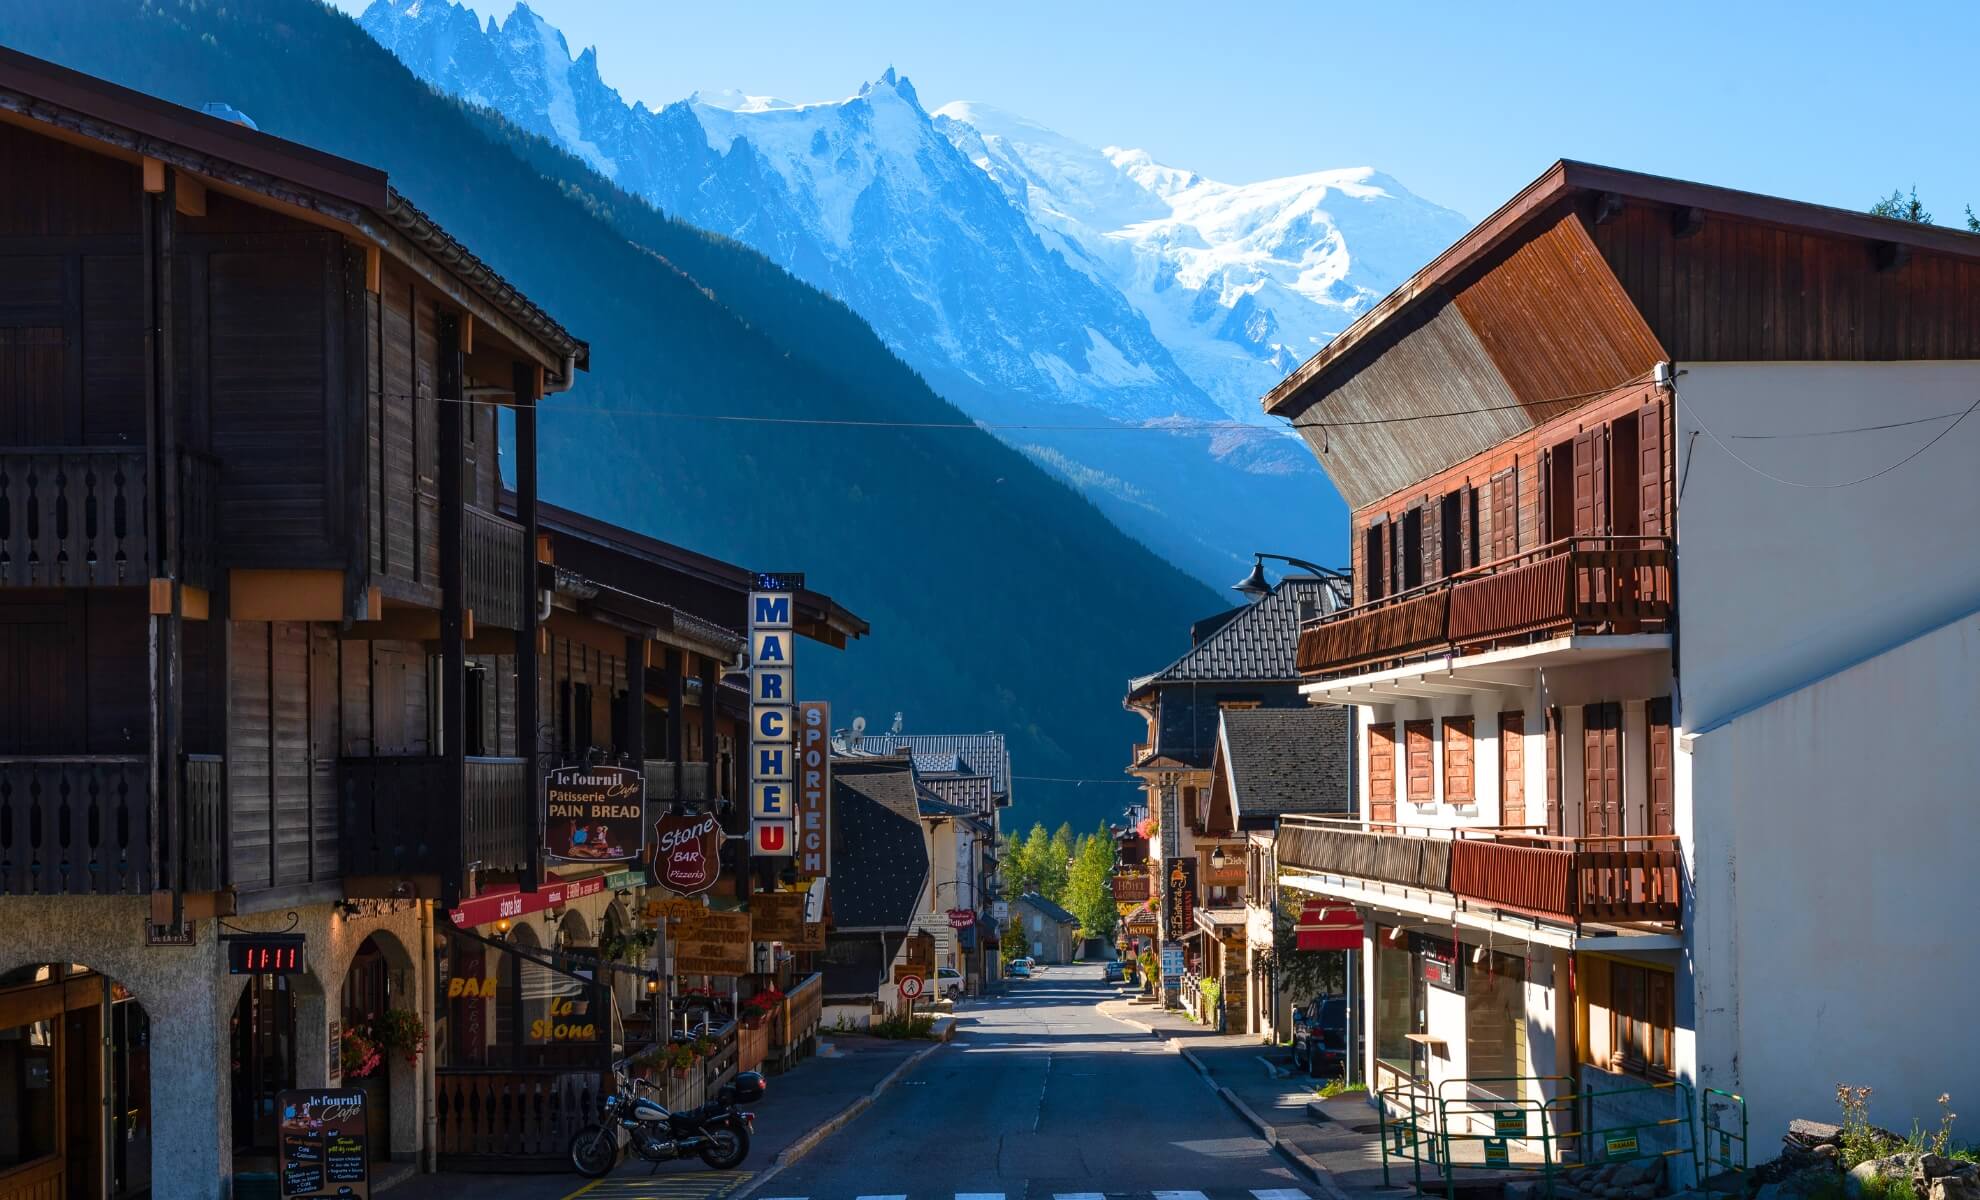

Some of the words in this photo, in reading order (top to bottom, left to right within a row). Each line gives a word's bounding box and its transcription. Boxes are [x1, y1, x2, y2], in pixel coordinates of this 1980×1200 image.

[556, 772, 570, 785] le
[572, 772, 622, 786] fournil
[549, 790, 605, 802] Pâtisserie
[805, 708, 822, 872] SPORTECH
[549, 804, 584, 817] PAIN
[591, 805, 640, 818] BREAD
[660, 818, 713, 851] Stone
[673, 851, 699, 862] BAR
[670, 870, 704, 880] Pizzeria
[1129, 926, 1154, 935] HOTEL
[247, 948, 295, 968] 11:11
[448, 977, 498, 999] BAR
[550, 996, 574, 1017] Le
[530, 1019, 595, 1040] Stone
[322, 1094, 361, 1106] fournil
[321, 1104, 361, 1122] Café
